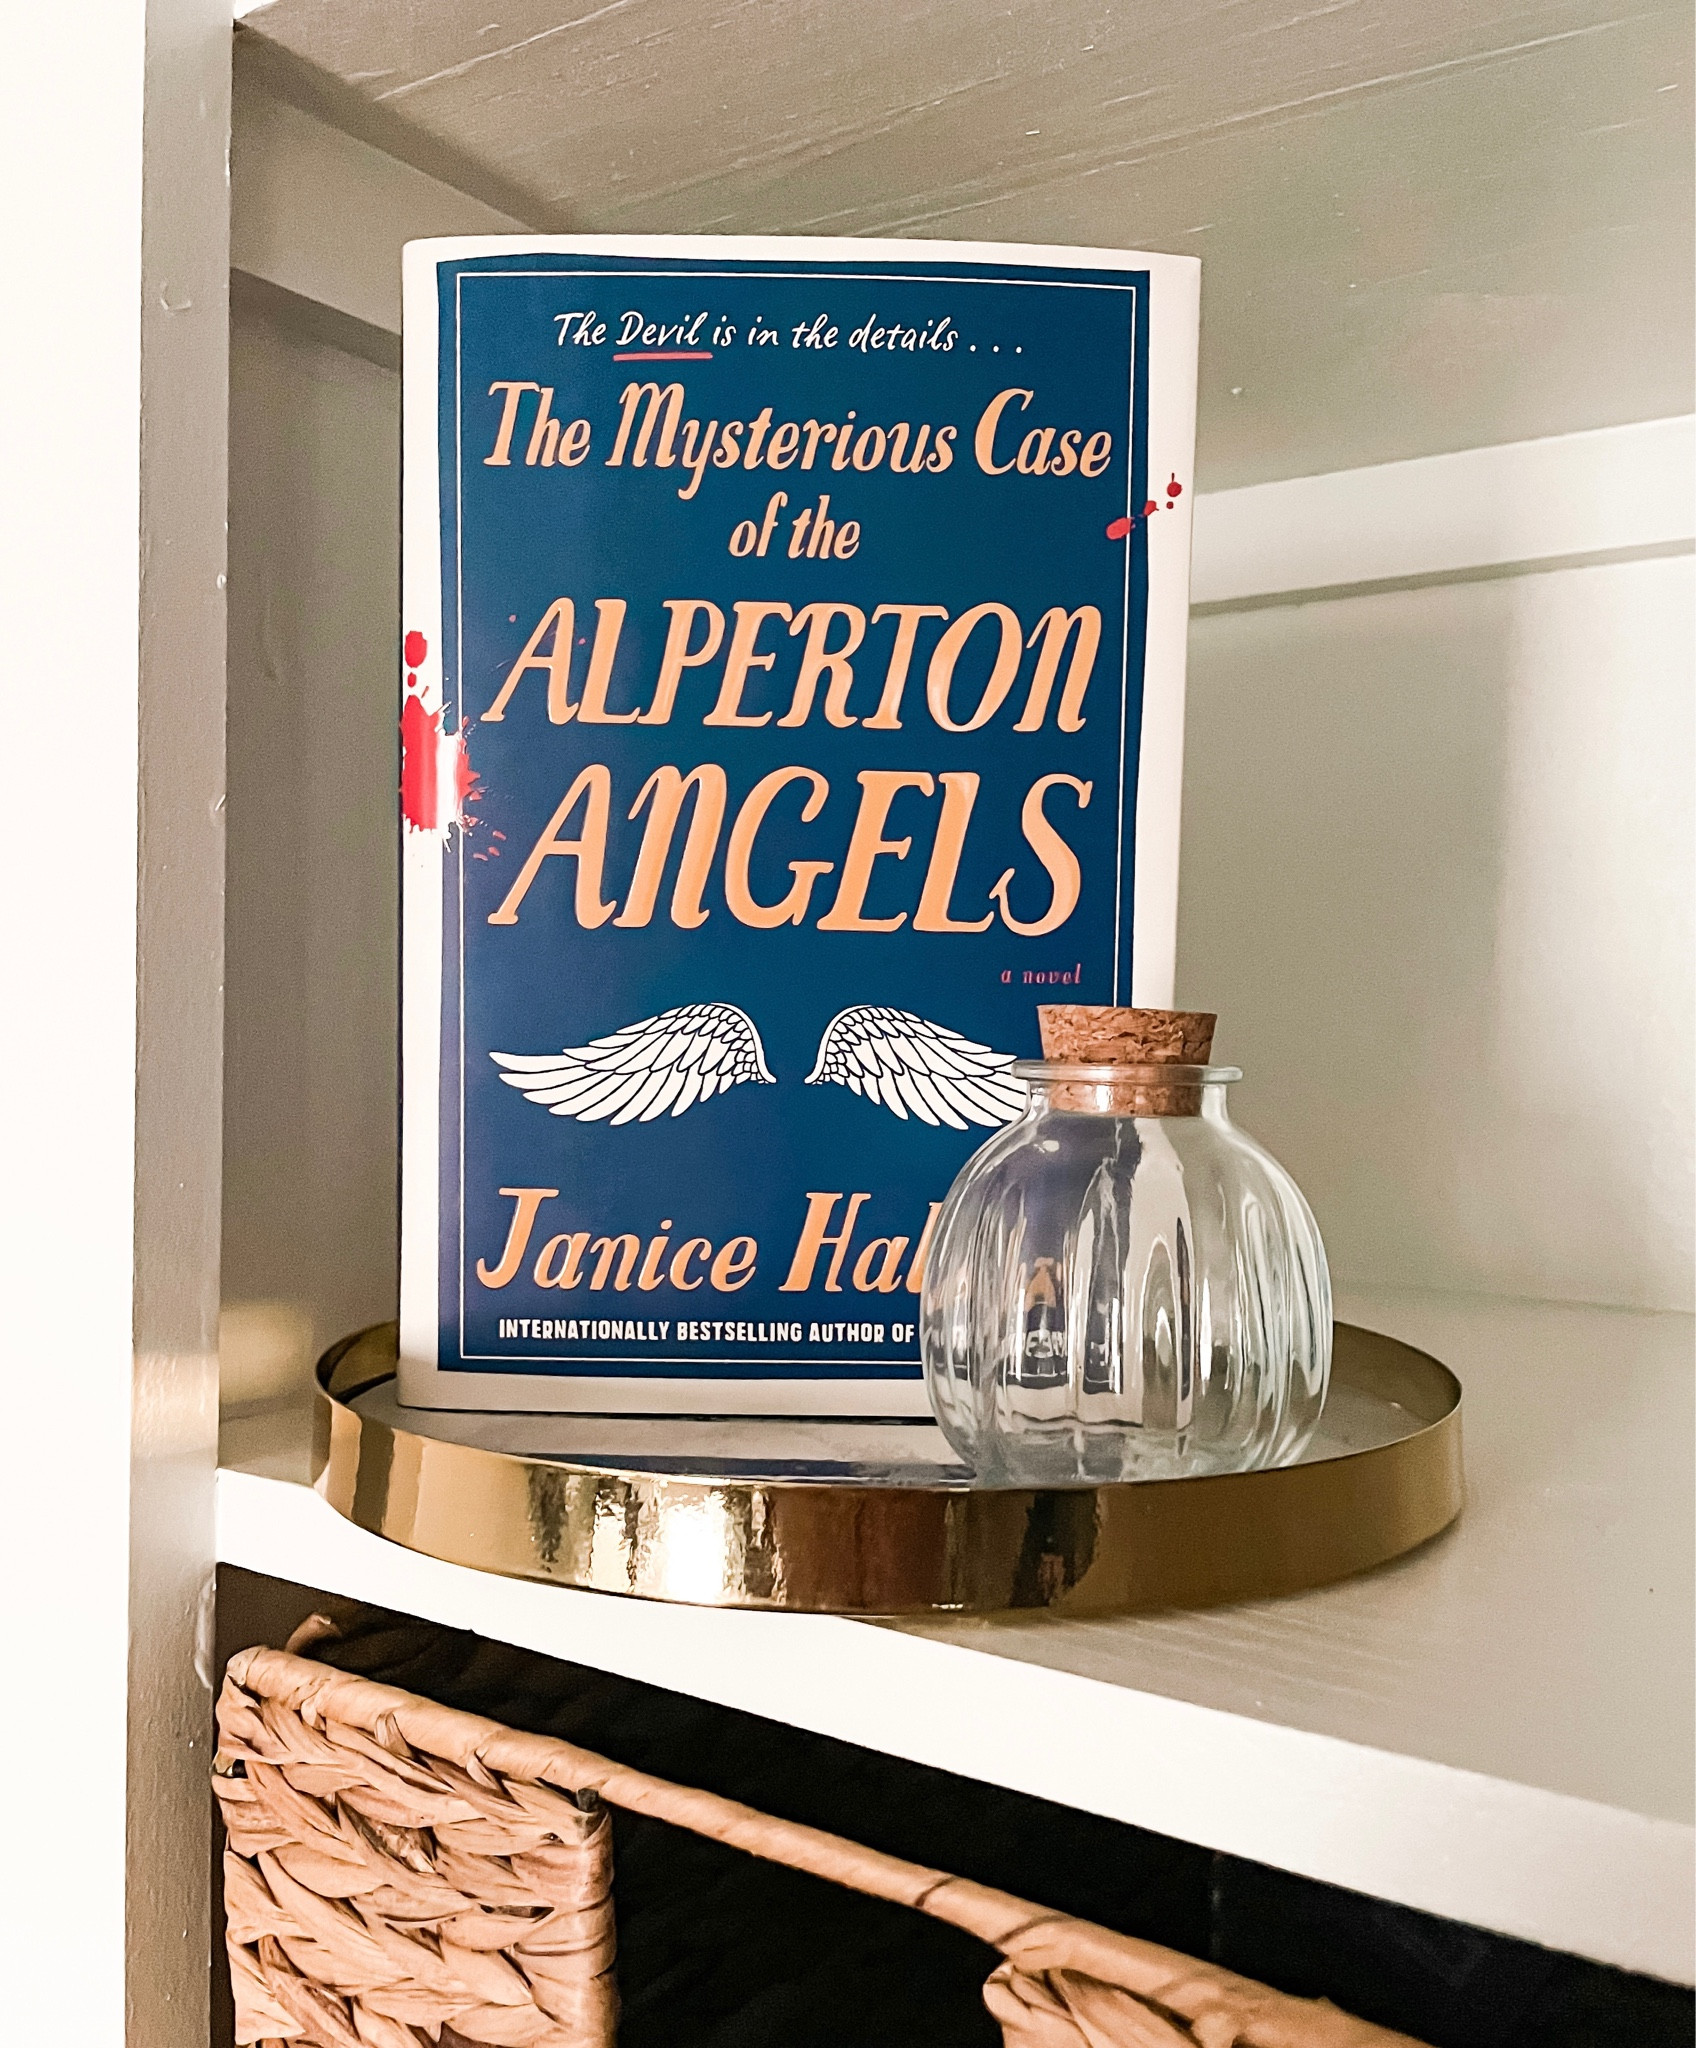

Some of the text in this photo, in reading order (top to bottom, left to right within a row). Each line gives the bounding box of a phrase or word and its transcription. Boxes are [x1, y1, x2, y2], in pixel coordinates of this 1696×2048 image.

[553, 310, 607, 347] The
[615, 310, 707, 347] Devil
[712, 314, 737, 347] is
[747, 315, 779, 347] in
[791, 313, 839, 350] the
[483, 381, 1112, 501] The Mysterious Case
[728, 491, 861, 560] of the
[481, 596, 1102, 733] ALPERTON
[487, 763, 1093, 937] ANGELS
[1000, 962, 1082, 985] a novel
[475, 1187, 942, 1295] Janice Hal
[499, 1318, 915, 1344] INTERNATIONALLY BESTSELLING AUTHOR OF
